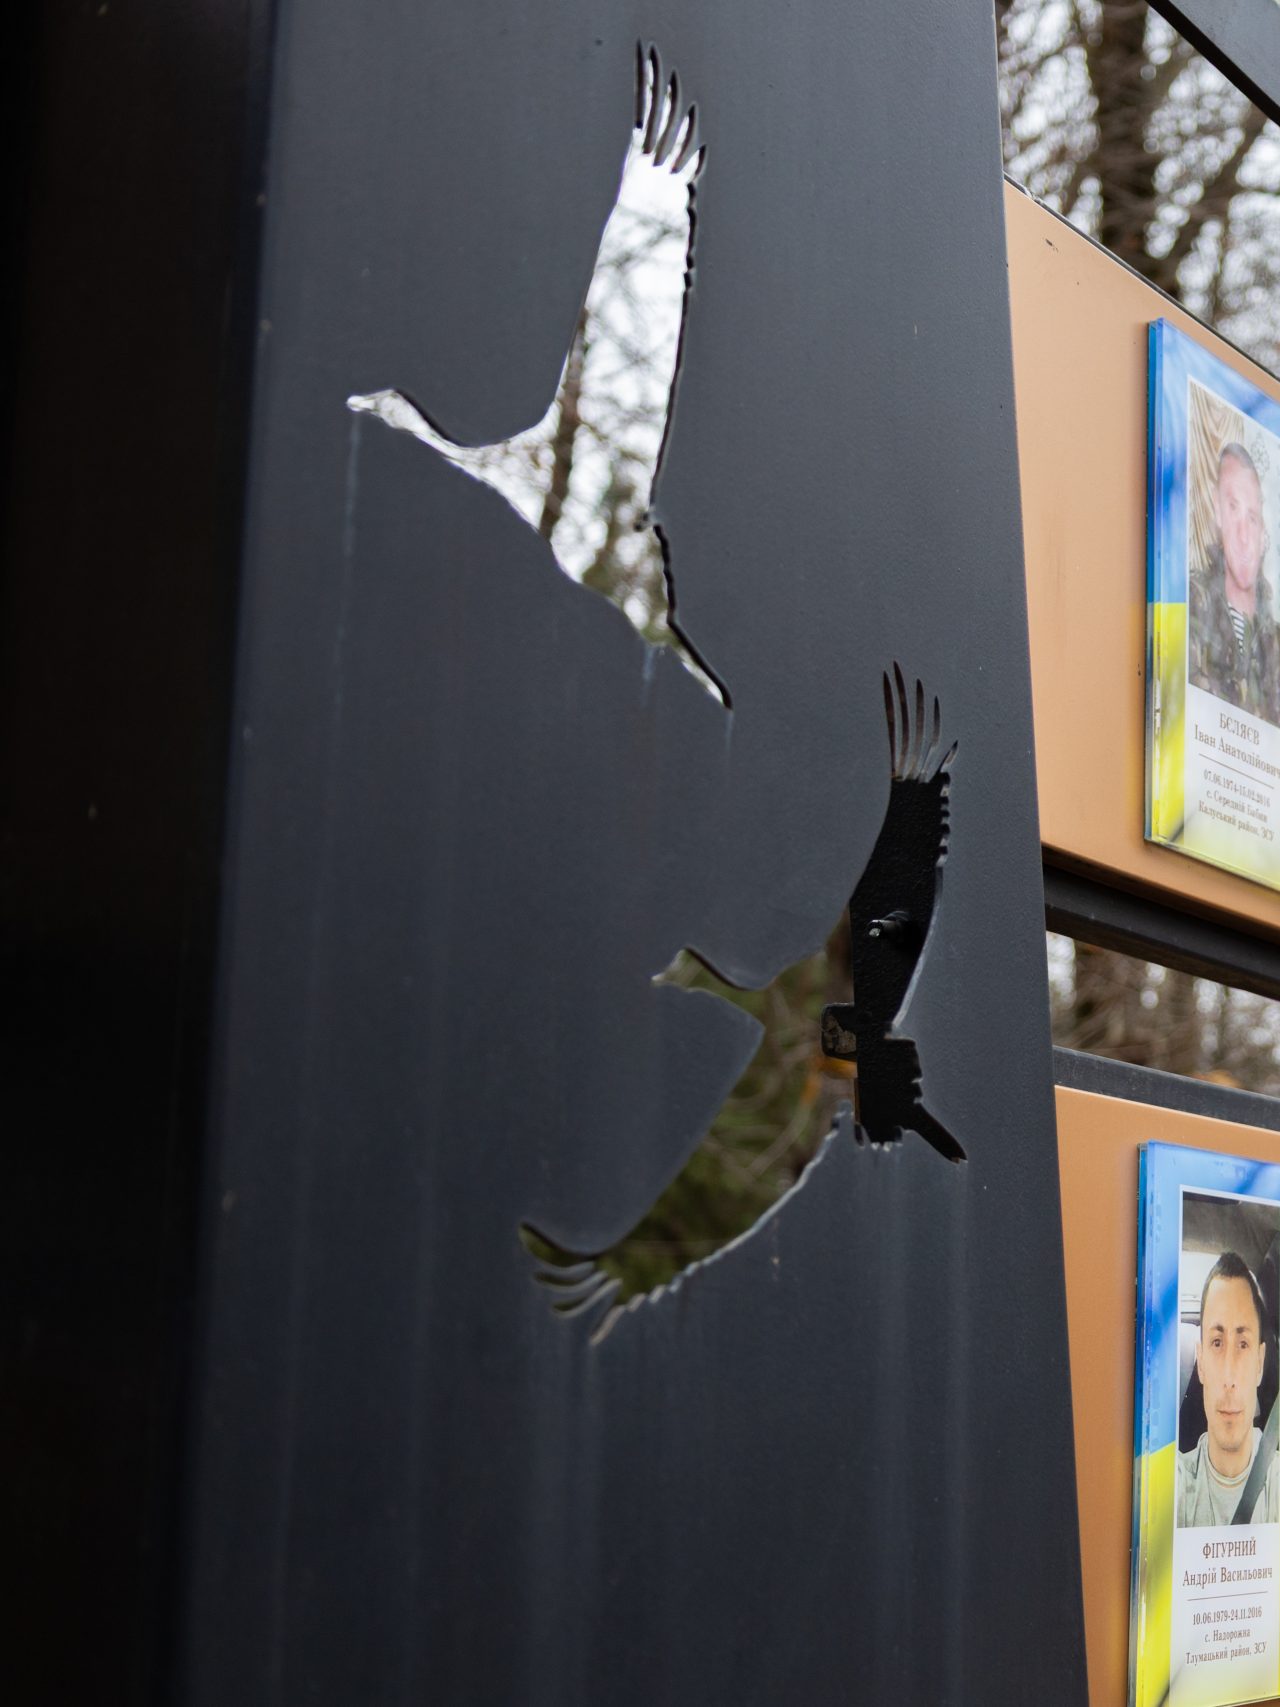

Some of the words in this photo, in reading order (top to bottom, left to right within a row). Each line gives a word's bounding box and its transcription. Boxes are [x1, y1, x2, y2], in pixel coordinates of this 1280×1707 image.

[1219, 712, 1260, 746] БЄЛЯЄВ
[1194, 724, 1216, 749] Іван
[1218, 737, 1280, 779] Анатолійович
[1202, 1536, 1257, 1560] ФІГУРНИЙ
[1182, 1567, 1217, 1589] Андрій
[1220, 1566, 1273, 1583] Васильович
[1193, 1606, 1262, 1625] 10.06.1979-24.11.2016
[1185, 1647, 1228, 1667] Тлумацький
[1254, 1641, 1267, 1654] ЗСУ
